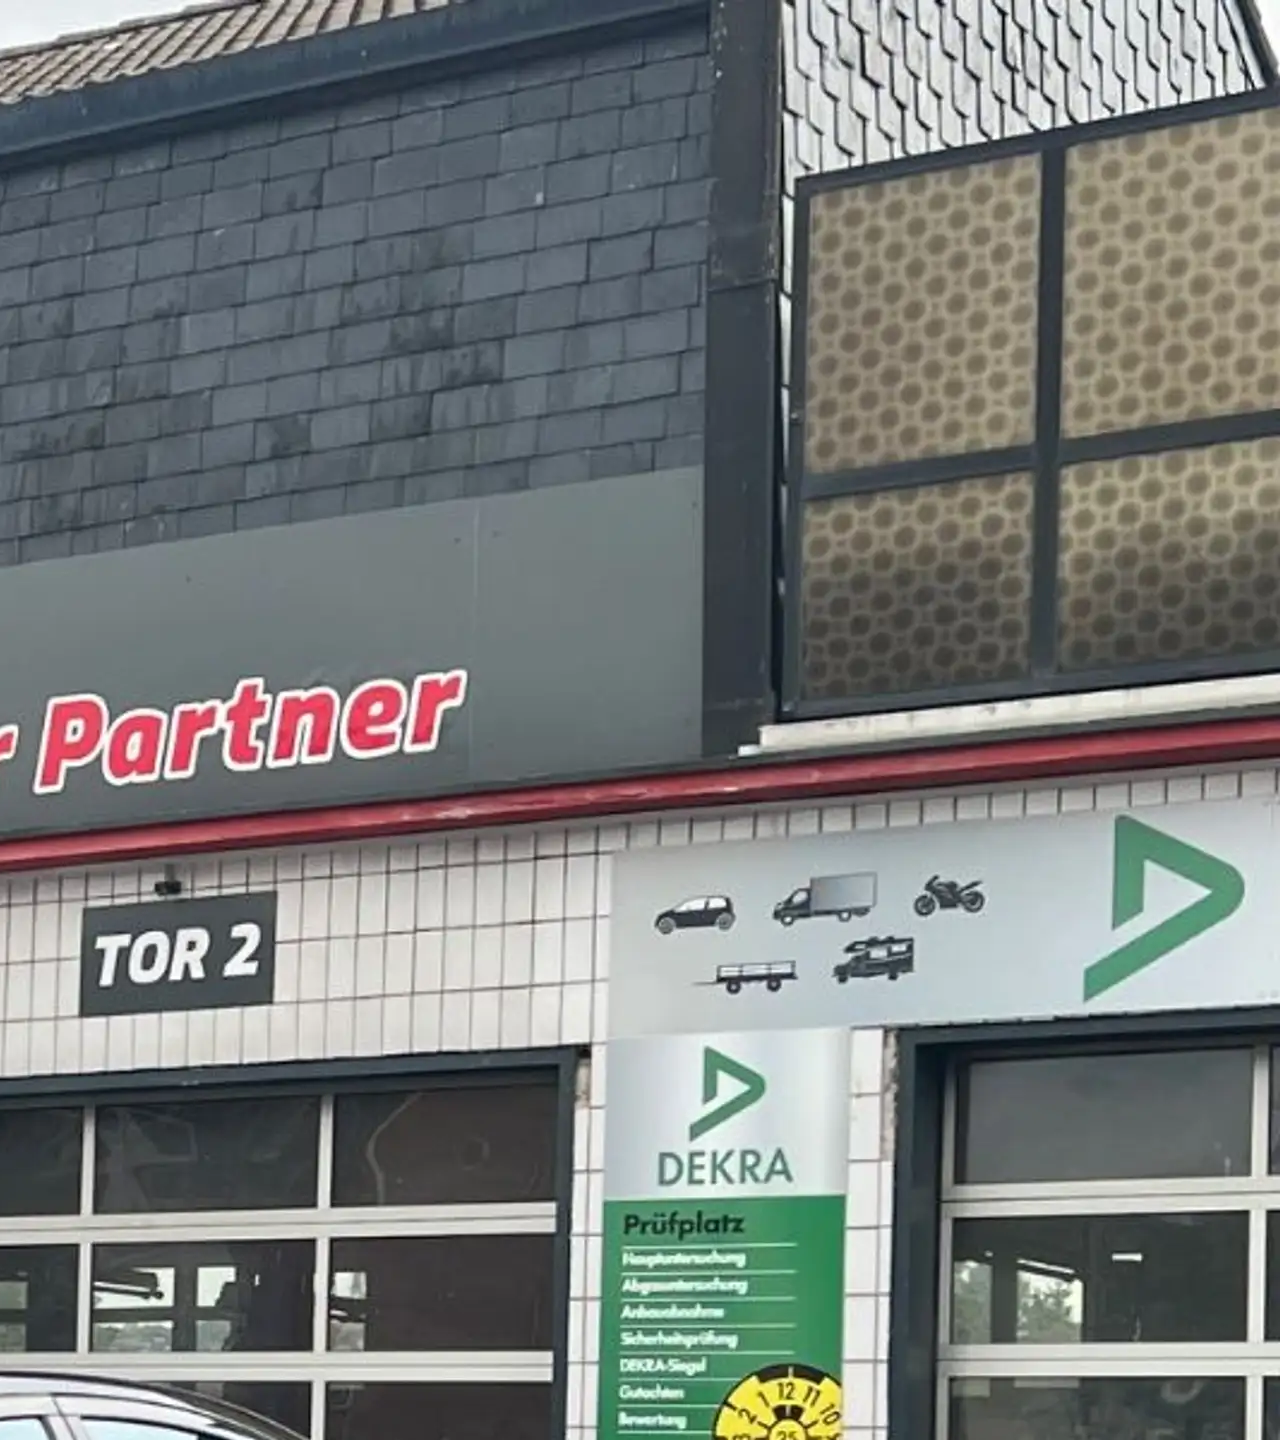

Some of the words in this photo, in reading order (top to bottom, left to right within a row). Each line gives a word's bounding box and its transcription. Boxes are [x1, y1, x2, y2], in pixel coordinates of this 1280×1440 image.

[32, 668, 468, 796] Partner
[93, 925, 211, 987] TOR
[222, 921, 262, 979] 2
[657, 1146, 794, 1187] DEKRA
[623, 1209, 745, 1241] Prüfplatz
[619, 1356, 707, 1376] DEKRA-Siegel
[619, 1383, 685, 1399] Gutachten
[778, 1382, 795, 1400] 12
[803, 1386, 822, 1408] 11
[738, 1408, 757, 1424] 2
[820, 1403, 841, 1426] 10
